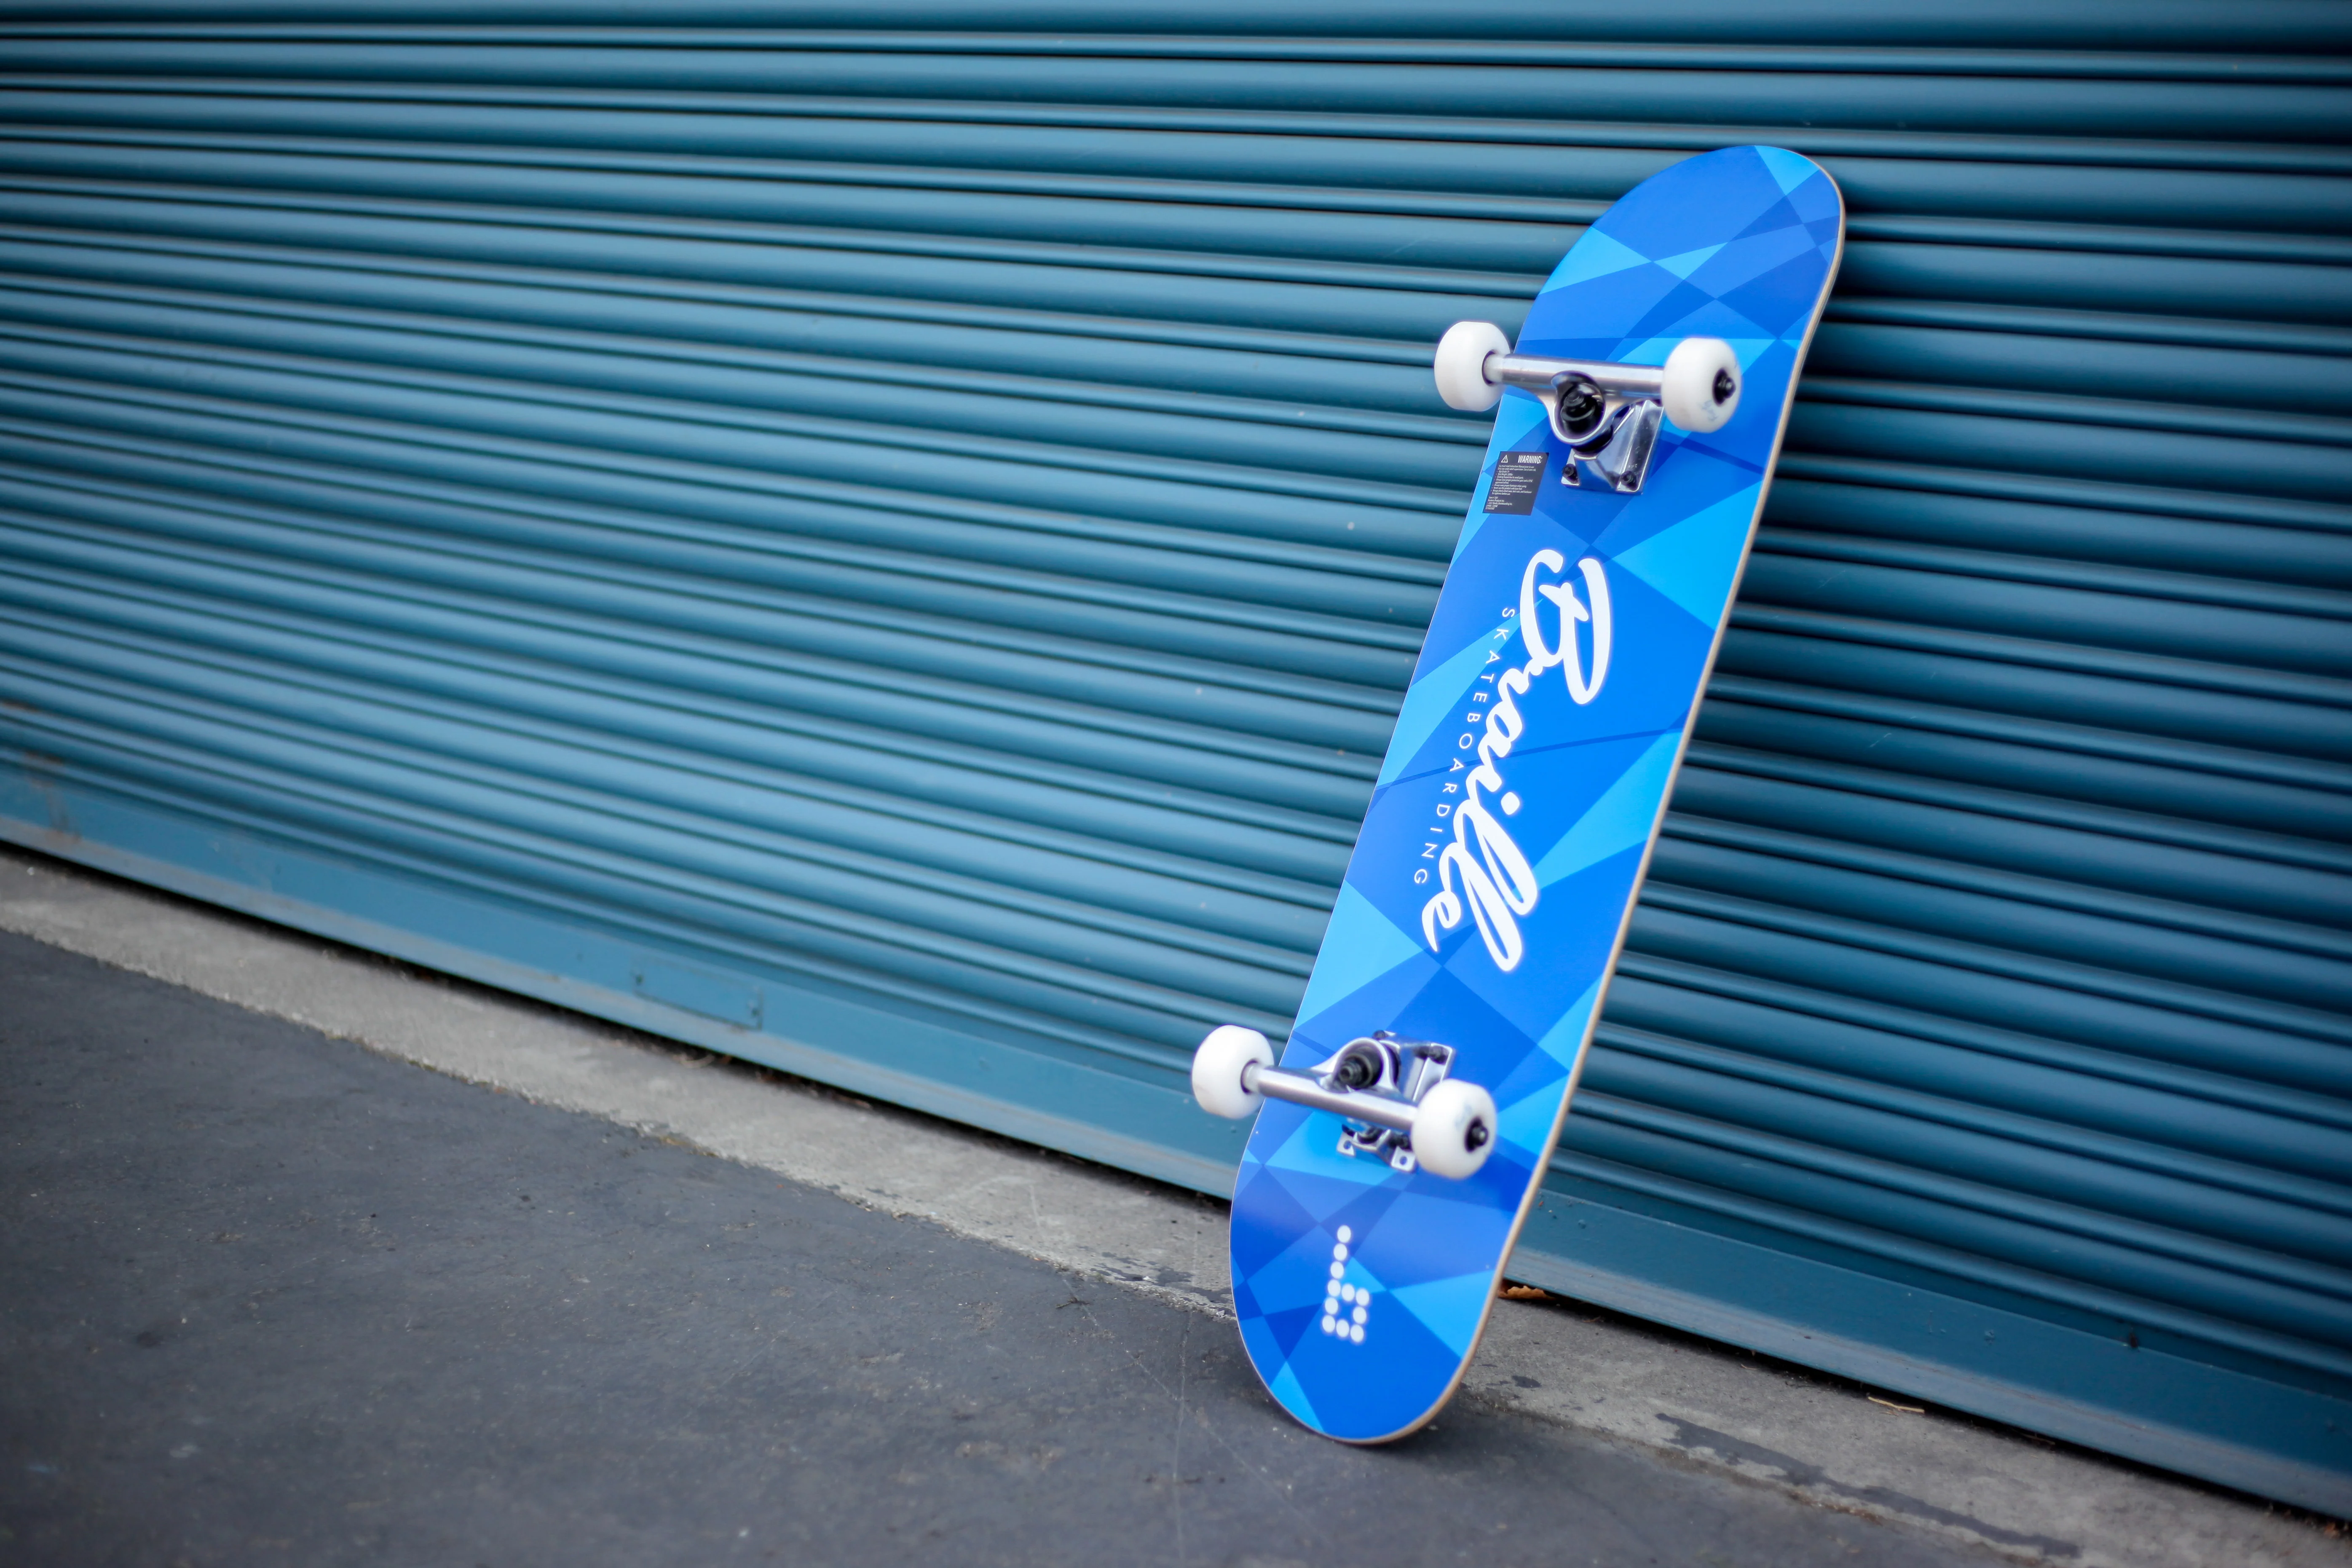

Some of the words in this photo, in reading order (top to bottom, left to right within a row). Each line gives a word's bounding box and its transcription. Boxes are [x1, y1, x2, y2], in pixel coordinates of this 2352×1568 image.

[1518, 455, 1543, 464] WARNING:
[1413, 607, 1516, 884] SKATEBOARDING
[1422, 549, 1611, 972] Braille
